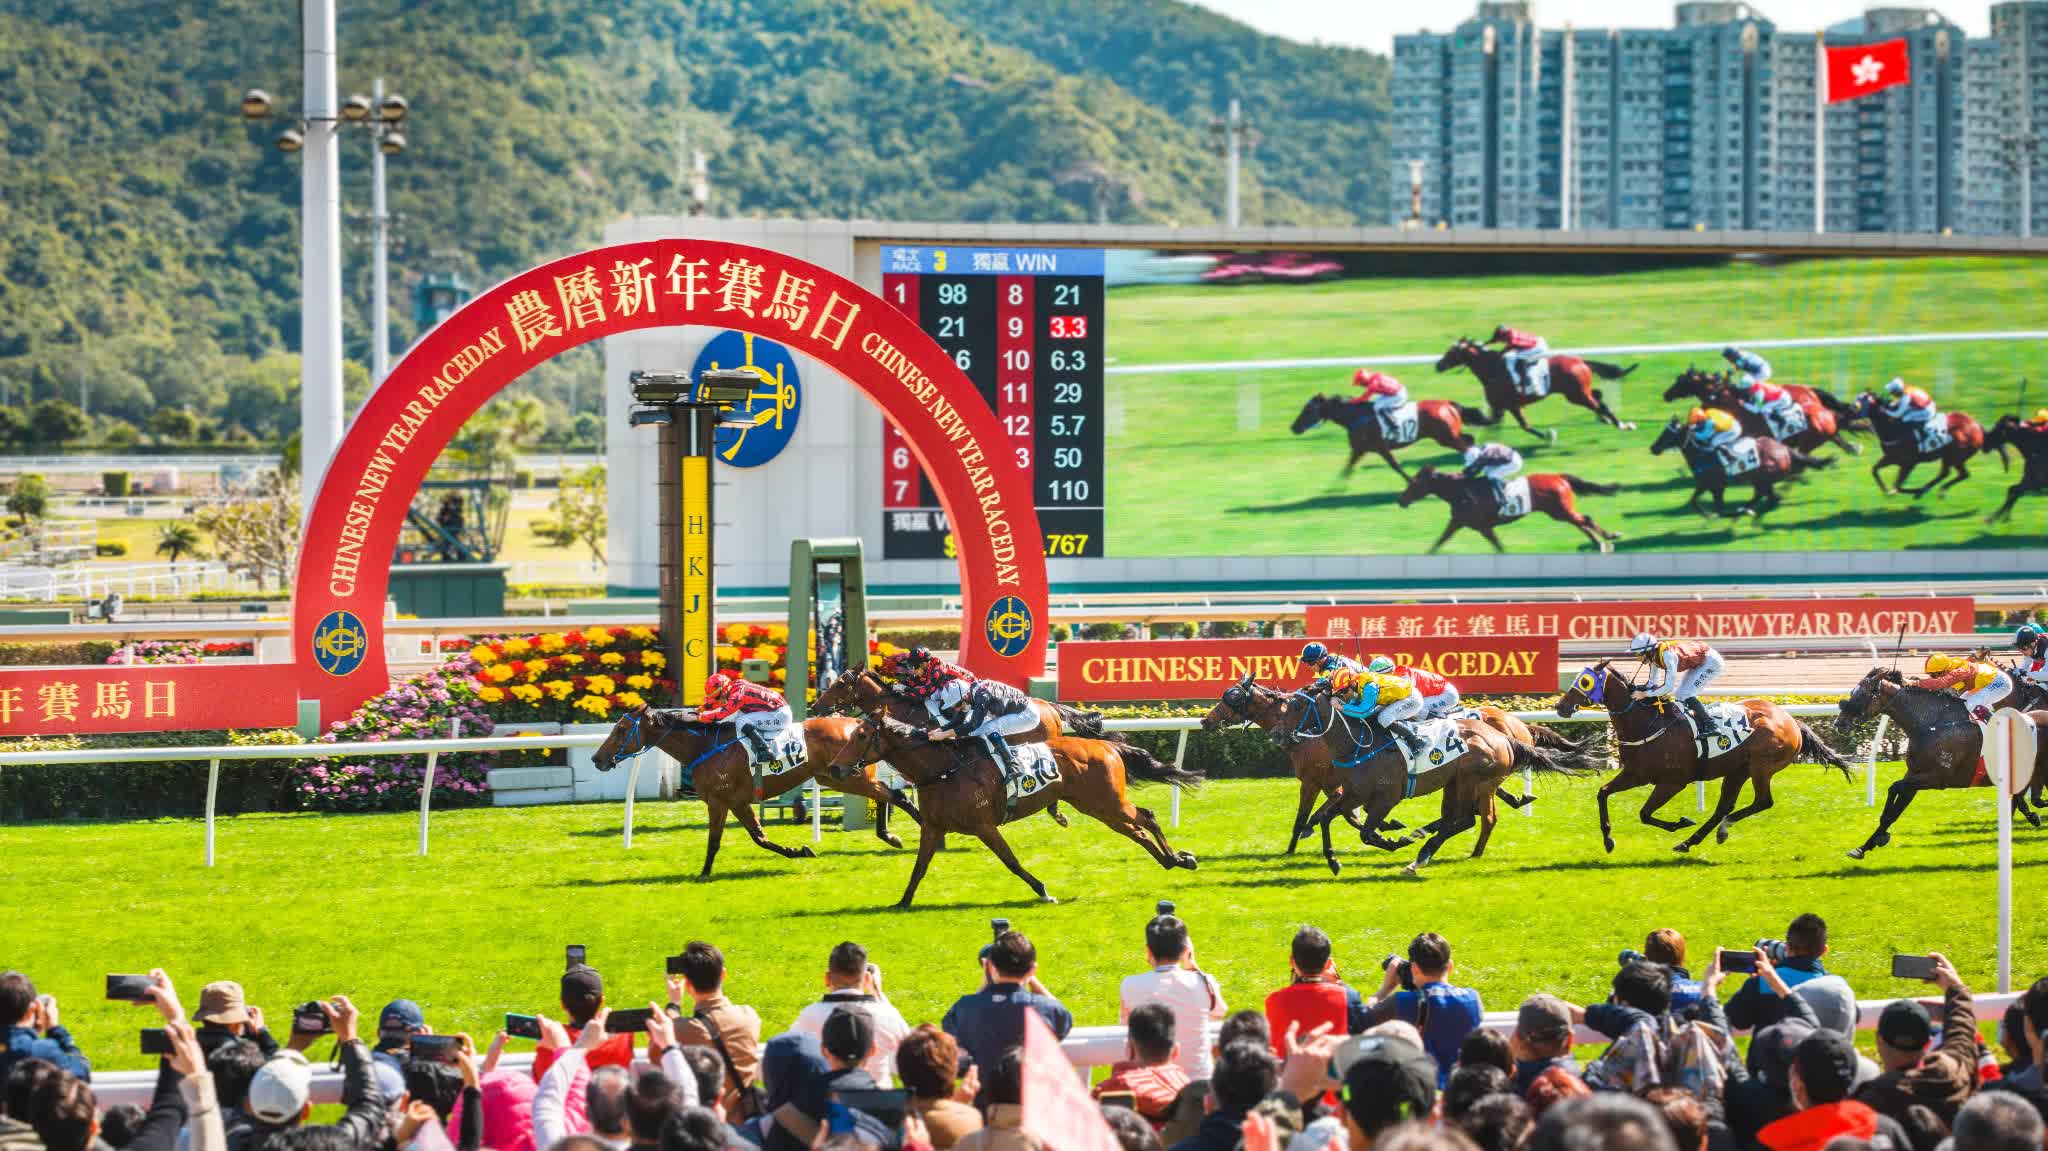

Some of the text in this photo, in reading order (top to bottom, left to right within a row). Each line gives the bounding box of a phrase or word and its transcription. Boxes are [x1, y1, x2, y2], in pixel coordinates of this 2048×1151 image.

[933, 250, 947, 272] 3
[1015, 253, 1057, 272] WIN
[503, 253, 861, 355] 農曆新年賽馬日
[894, 283, 1081, 305] 1 98 8 21
[938, 316, 1087, 338] 21 9 3.3
[1003, 350, 1030, 371] 10
[1050, 350, 1086, 371] 6.3
[1003, 382, 1082, 404] 11 29
[1003, 415, 1086, 436] 12 5.7
[329, 326, 507, 597] CHINESE NEW YEAR RACEDAY
[861, 332, 1020, 587] CHINESE NEW YEAR RACEDAY
[893, 447, 909, 469] 6
[1054, 447, 1082, 468] 50
[893, 479, 1089, 502] 7 110
[1568, 611, 1960, 639] CHINESE NEW YEAR RACEDAY
[1081, 655, 1224, 684] CHINESE
[1228, 654, 1301, 682] NEW
[1445, 729, 1464, 754] 4
